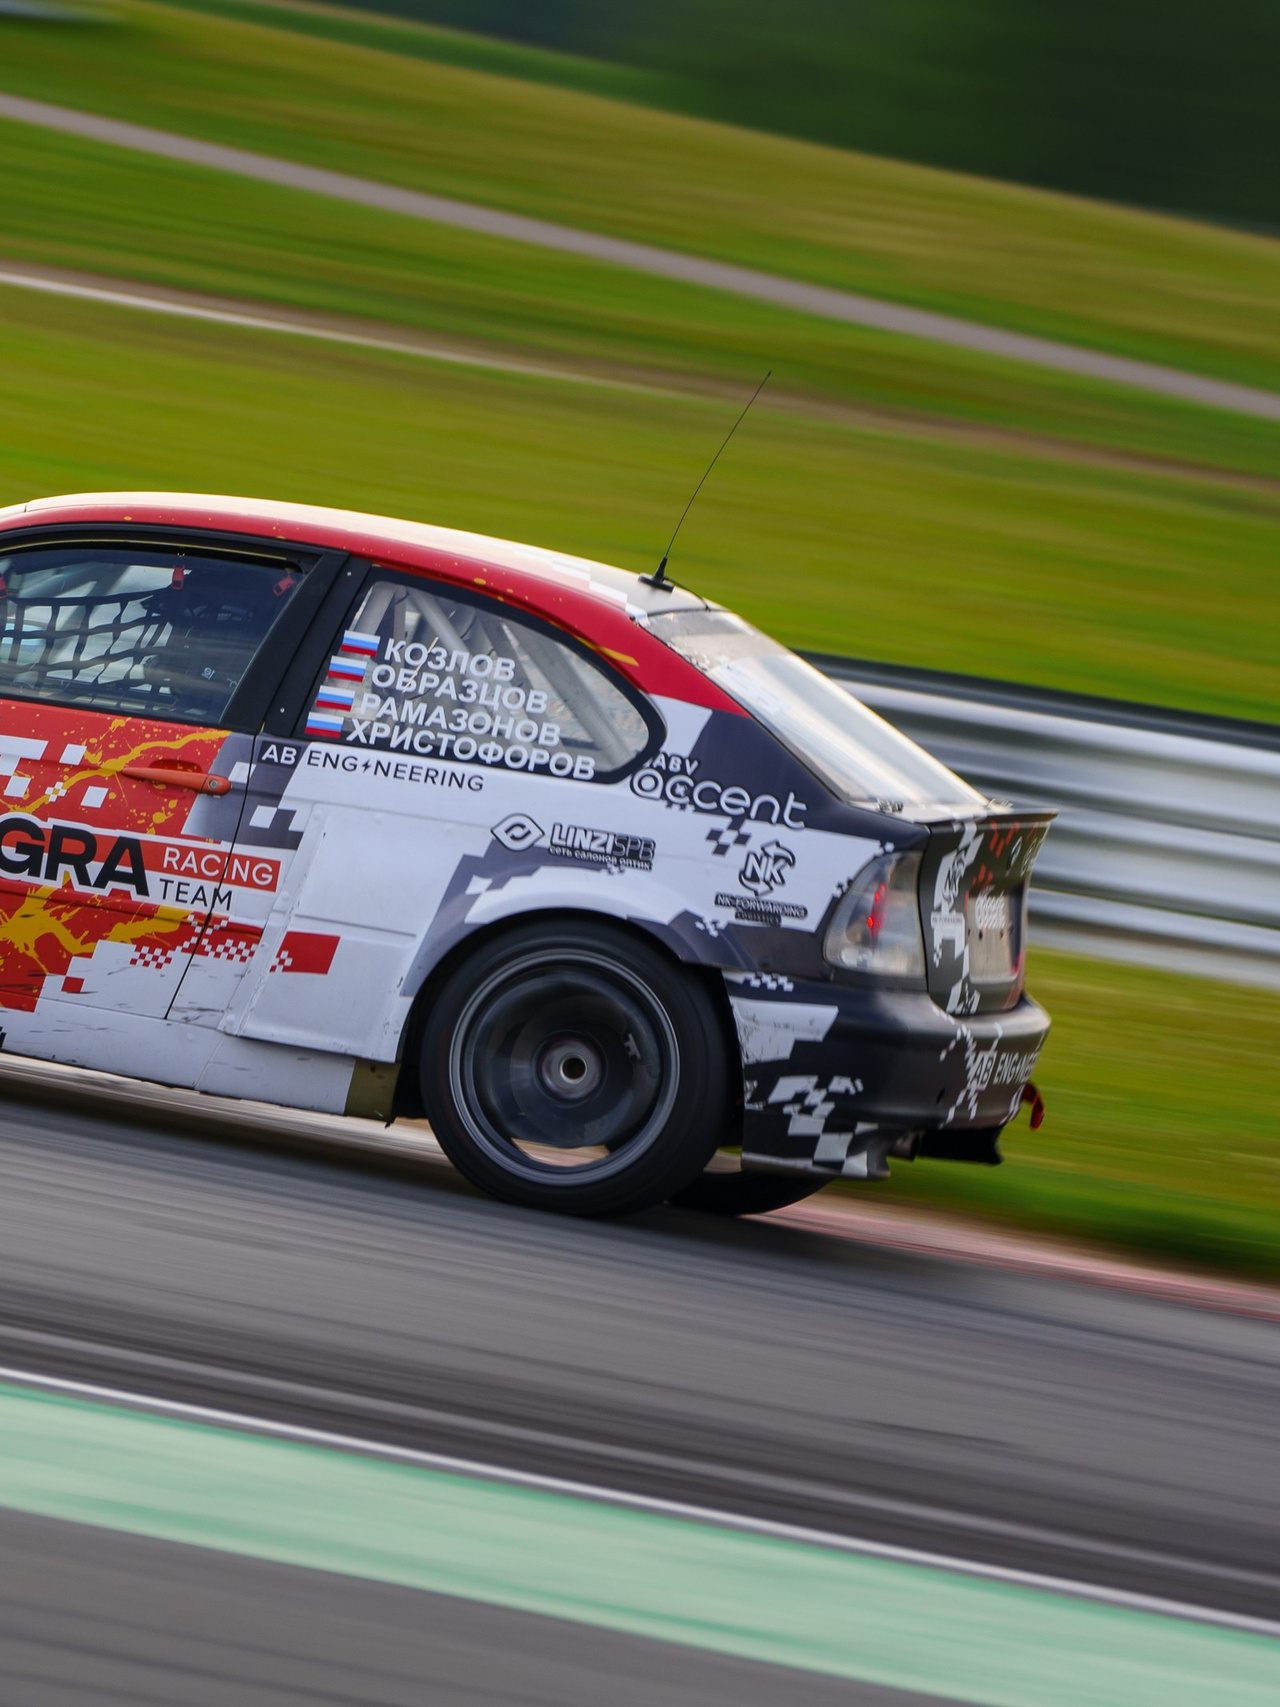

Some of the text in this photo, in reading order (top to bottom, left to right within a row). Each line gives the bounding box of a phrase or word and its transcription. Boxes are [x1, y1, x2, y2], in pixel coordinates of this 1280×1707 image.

[384, 638, 516, 682] КОЗЛОВ
[371, 664, 549, 715] ОБРАЗЦОВ
[359, 692, 561, 747] РАМАЗОНОВ
[261, 744, 297, 766] AB
[346, 718, 596, 781] ХРИСТОФОРОВ
[652, 752, 699, 776] ABV
[632, 768, 807, 828] accent
[163, 846, 273, 886] RACING
[745, 851, 788, 885] NK
[160, 878, 233, 911] TEAM
